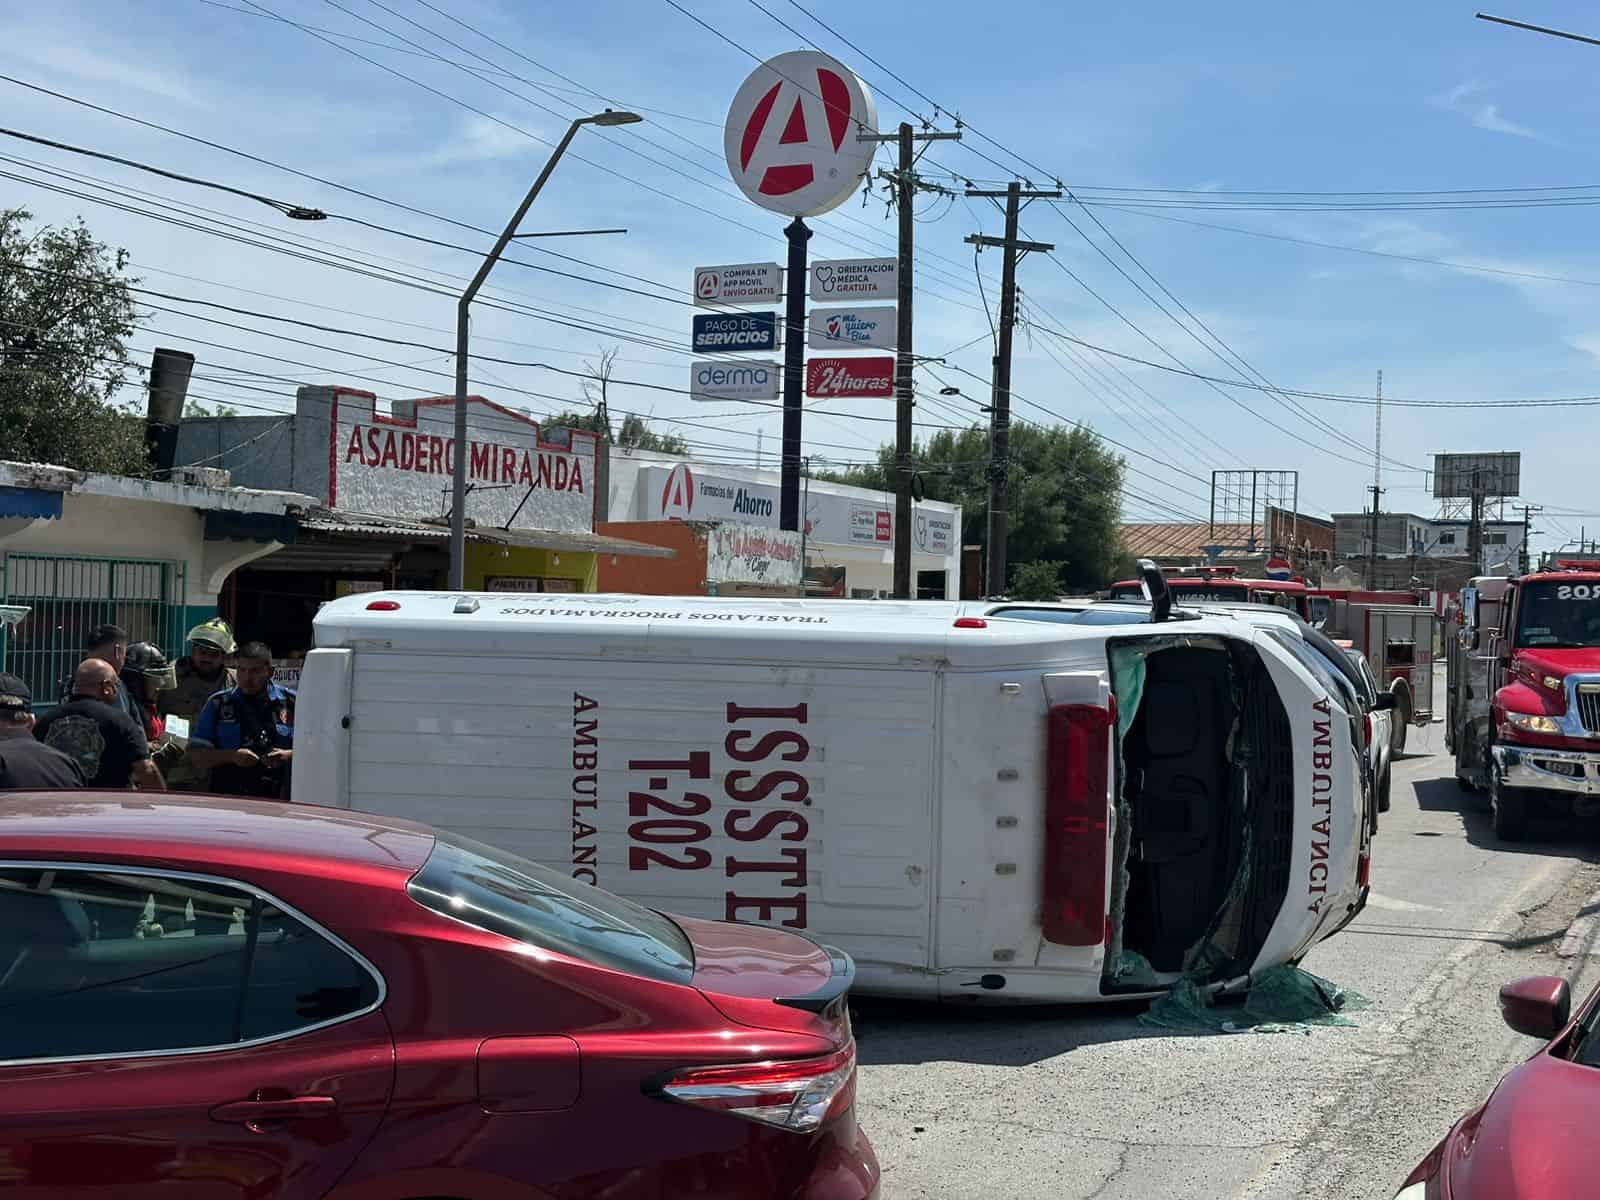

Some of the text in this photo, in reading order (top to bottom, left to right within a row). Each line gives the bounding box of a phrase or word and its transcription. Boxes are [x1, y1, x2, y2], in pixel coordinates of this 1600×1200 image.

[723, 268, 768, 278] COMPRA EN
[723, 279, 739, 287] APP
[837, 283, 878, 292] GRATUITA
[748, 287, 775, 296] GRATIS
[705, 319, 758, 331] PAGO DE
[695, 330, 770, 346] SERVICIOS
[697, 366, 768, 385] derma
[469, 441, 585, 494] MIRANDA
[700, 482, 726, 499] Farmacias
[732, 487, 773, 517] Ahorro
[500, 607, 829, 624] TRASLADOS PROGRAMADOS
[627, 751, 712, 871] T-202
[723, 702, 810, 929] ISSSTE
